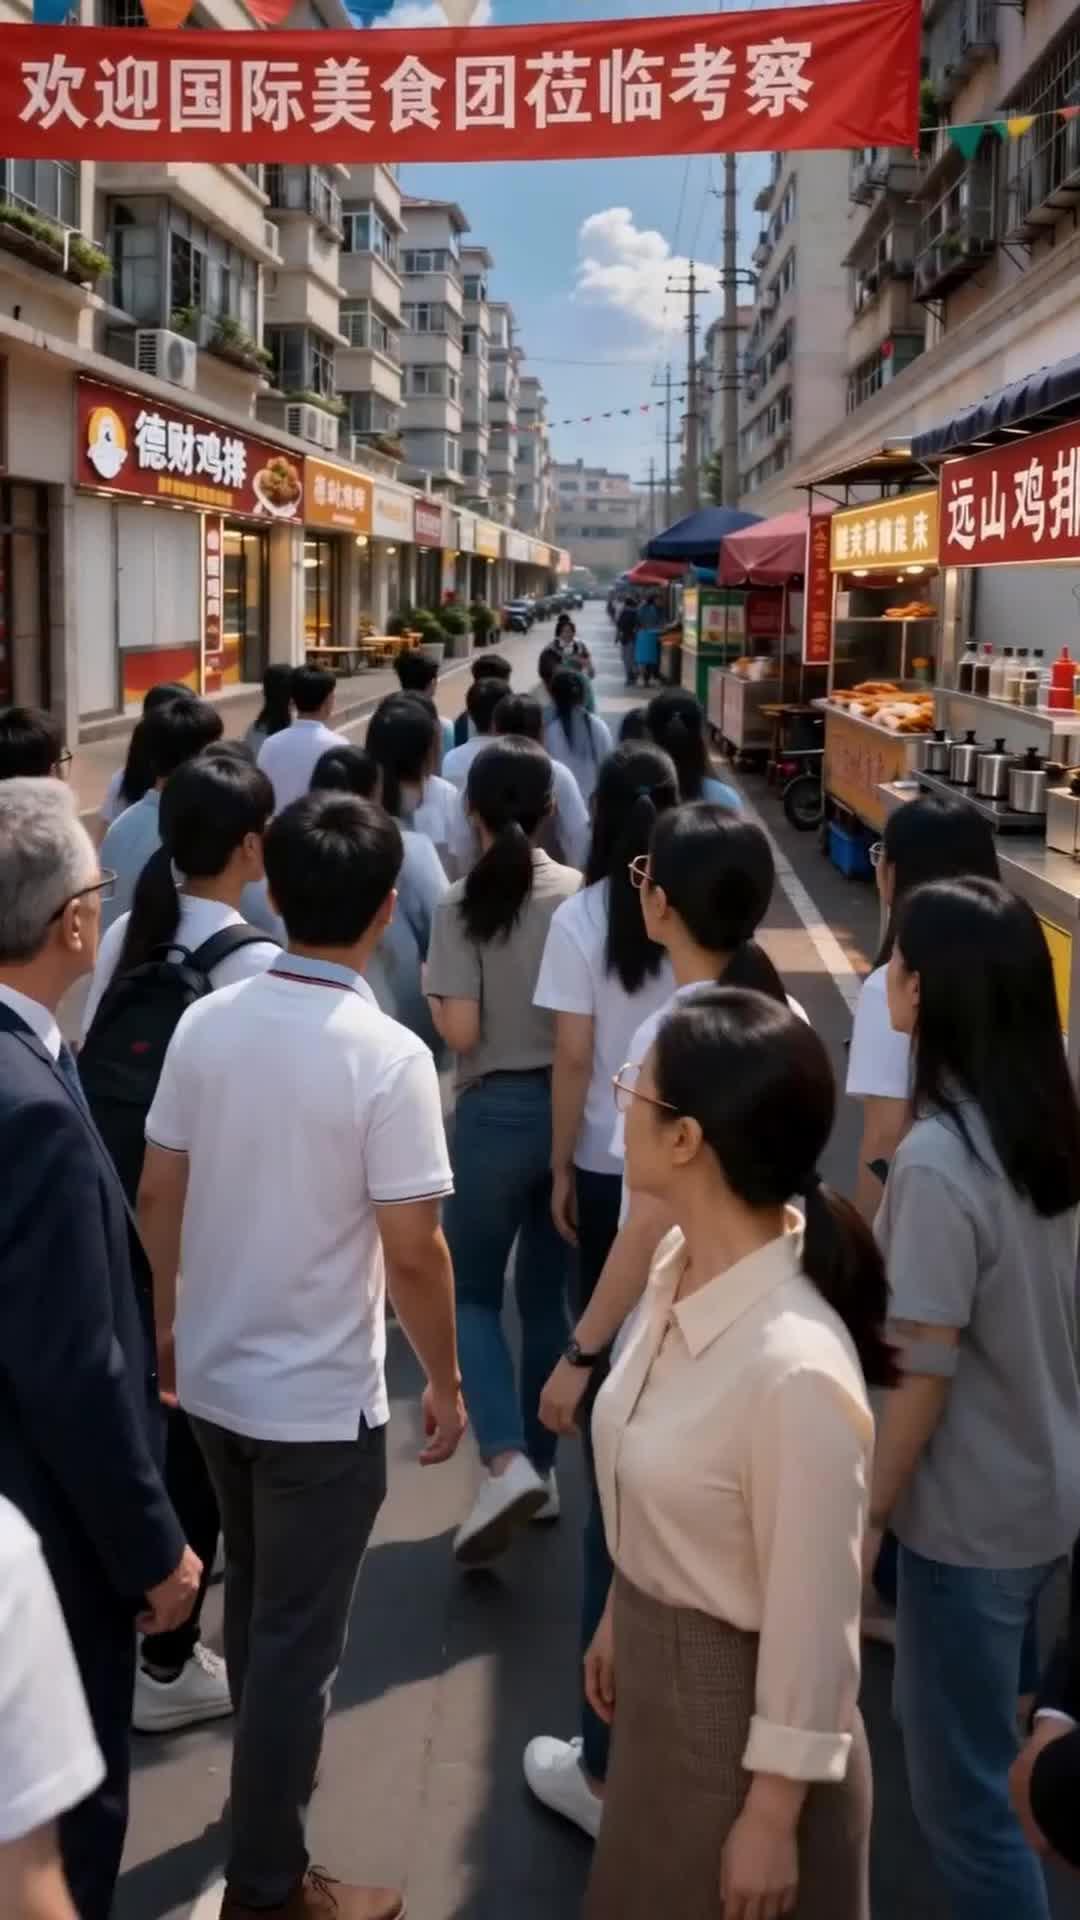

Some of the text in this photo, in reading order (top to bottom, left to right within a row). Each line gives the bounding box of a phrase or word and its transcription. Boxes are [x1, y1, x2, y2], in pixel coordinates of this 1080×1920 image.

[19, 37, 814, 133] 欢迎国际美食团莅临考察
[135, 410, 247, 488] 德财鸡排
[947, 447, 1080, 550] 远山鸡排
